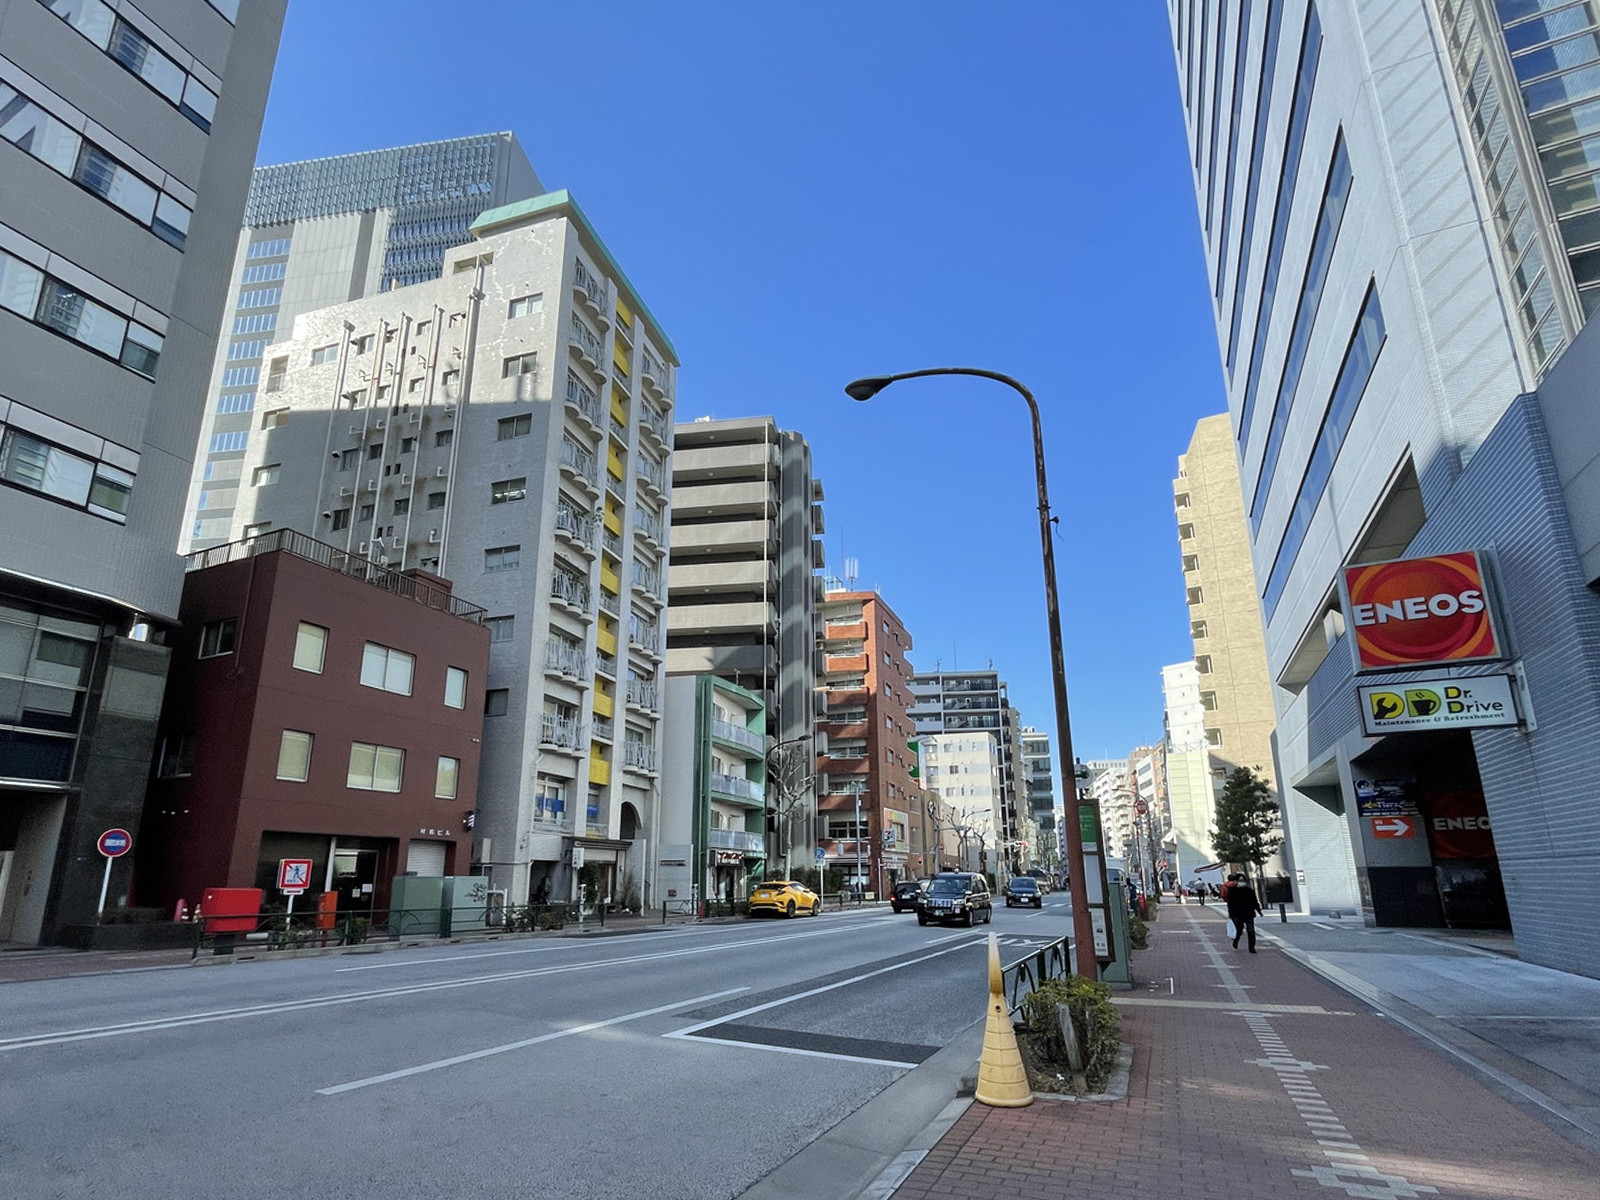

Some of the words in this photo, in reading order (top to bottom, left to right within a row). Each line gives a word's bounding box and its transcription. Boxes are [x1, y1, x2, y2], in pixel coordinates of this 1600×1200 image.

[1351, 590, 1485, 627] ENEOS
[1443, 686, 1472, 700] Dr.
[1446, 700, 1503, 714] Drive
[1374, 717, 1431, 727] Maintenance
[1444, 712, 1505, 722] Refreshment
